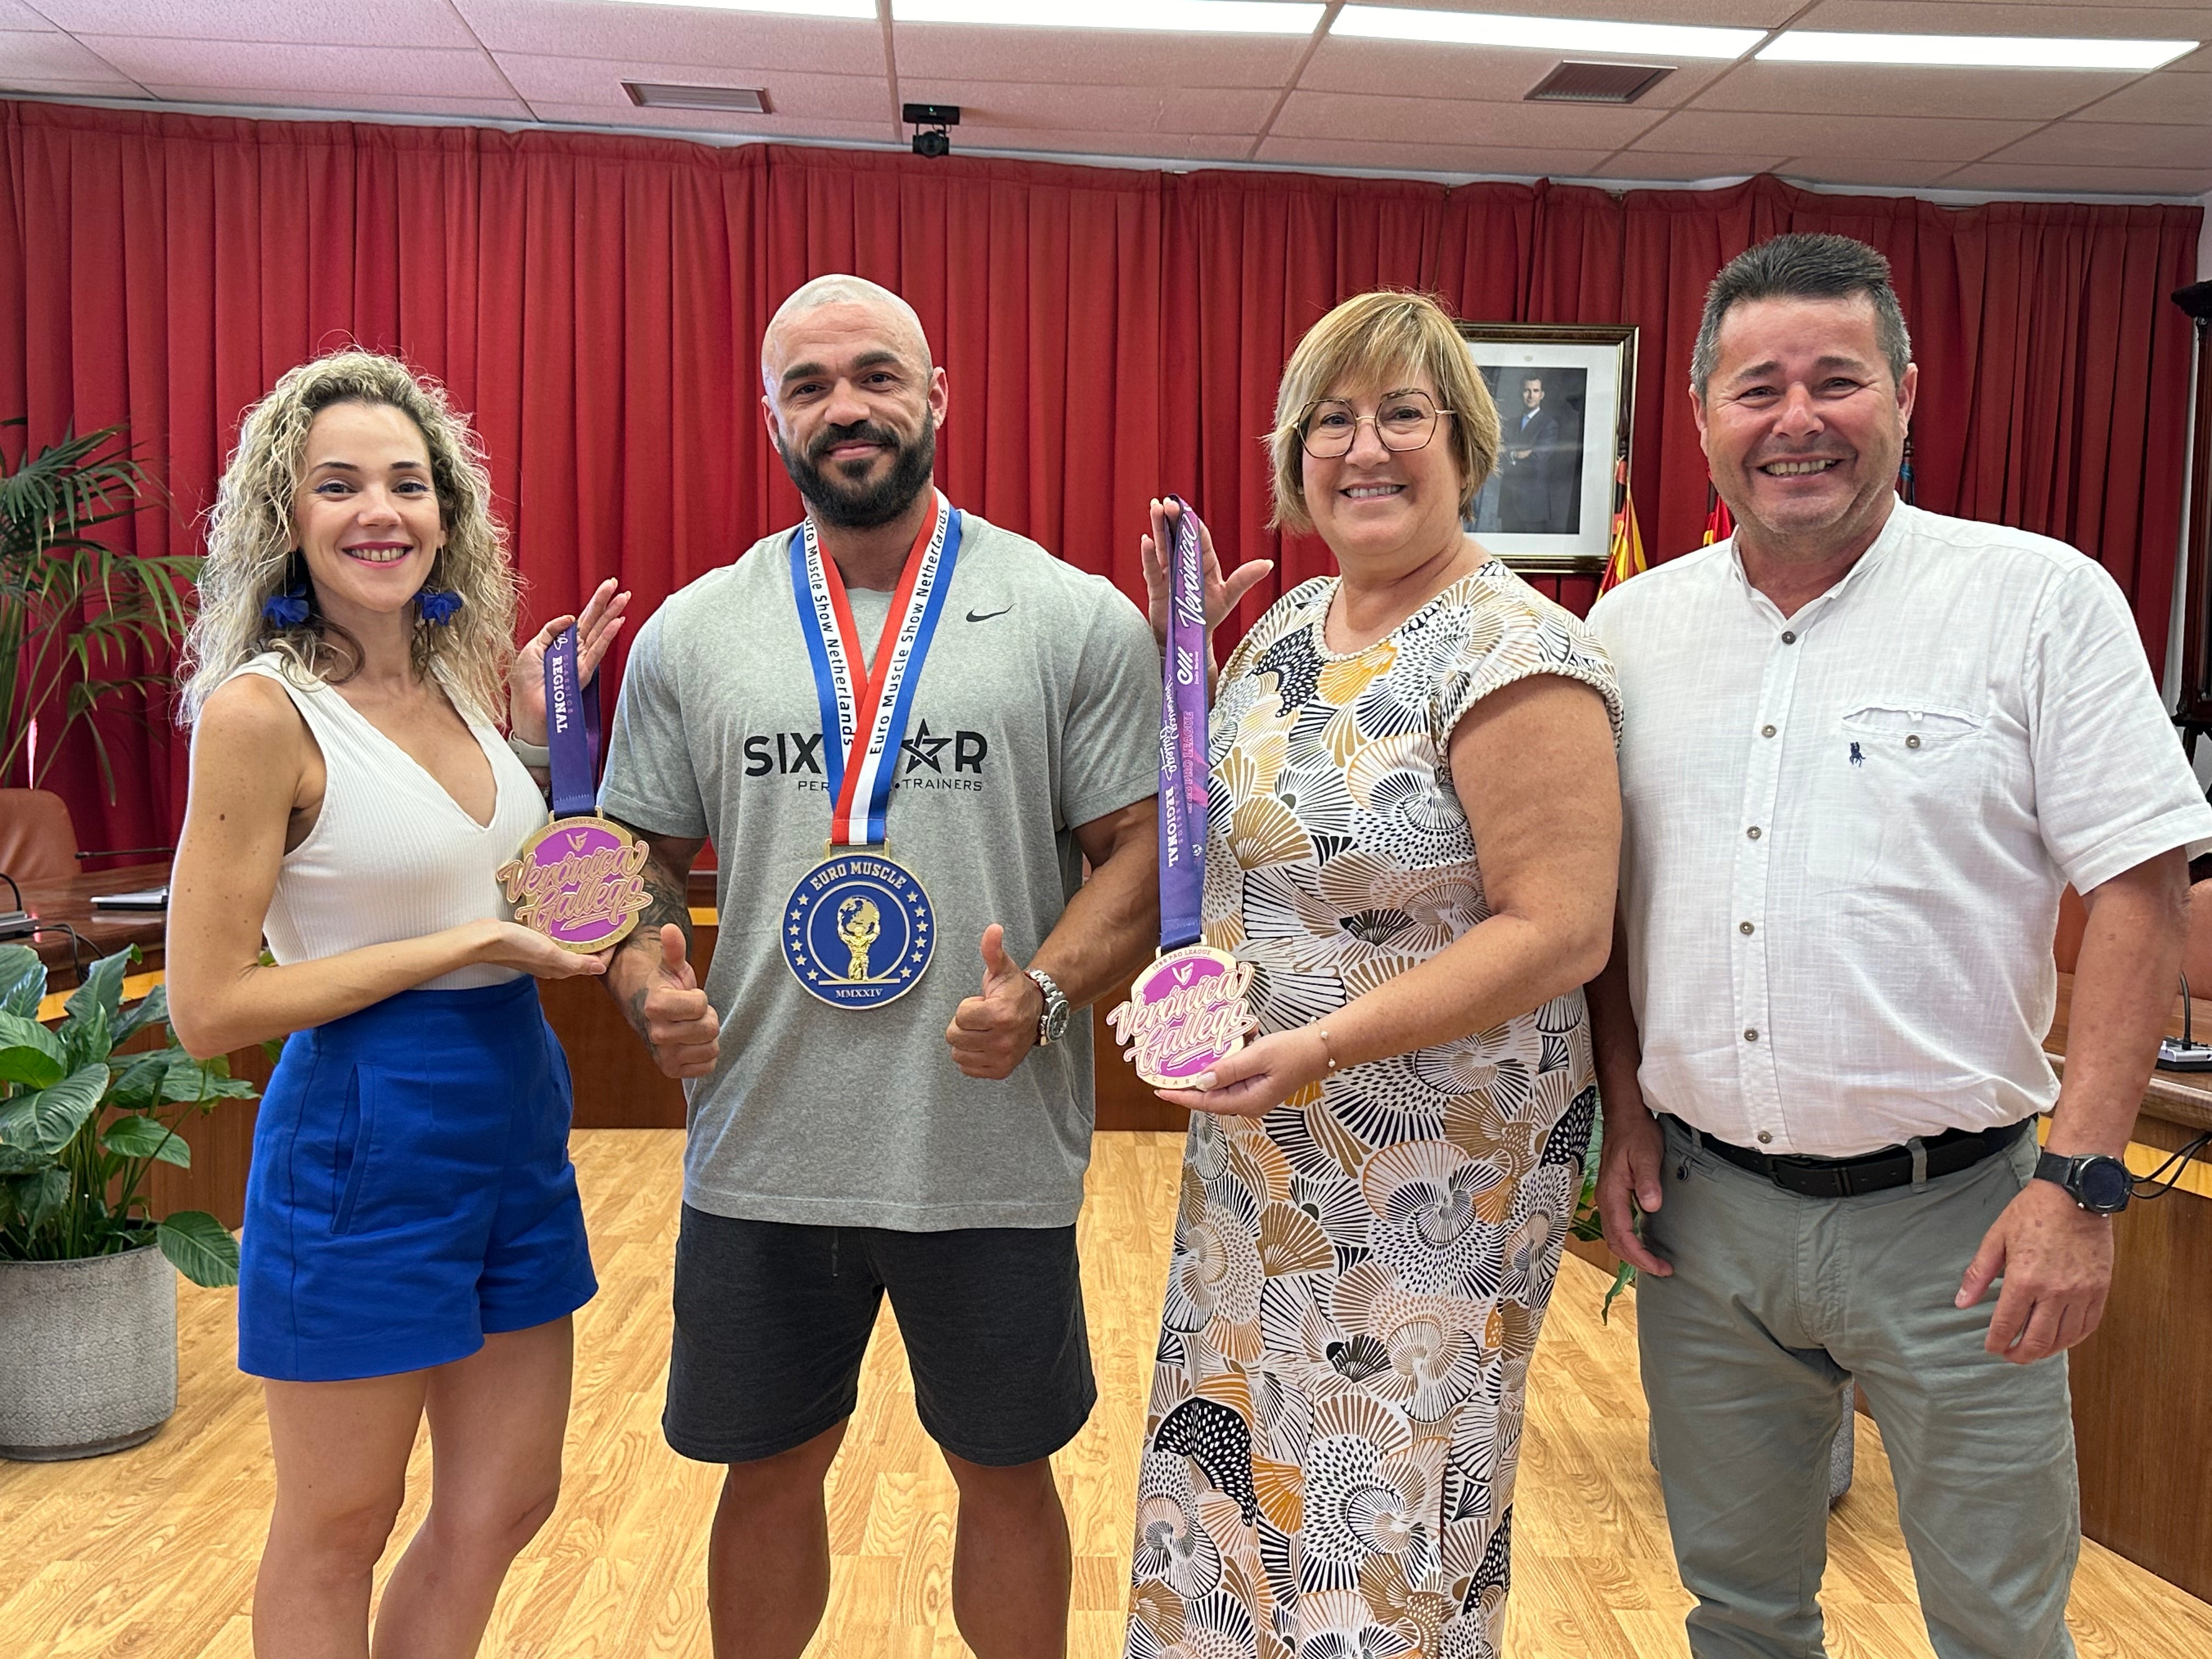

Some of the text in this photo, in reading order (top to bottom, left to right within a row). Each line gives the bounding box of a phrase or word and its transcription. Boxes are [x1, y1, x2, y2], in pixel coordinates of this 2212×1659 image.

[805, 518, 856, 746] uro Muscle Show Netherlands
[870, 509, 947, 755] Euro Muscle Show Netherlands
[552, 656, 568, 733] REGIONAL
[1182, 711, 1194, 758] LEAGUE
[902, 778, 984, 792] TRAINERS
[1165, 786, 1178, 867] REGIONAL
[515, 875, 653, 934] Gallego
[810, 861, 907, 891] EURO MUSCLE
[836, 989, 883, 998] MMXXIV
[1124, 998, 1260, 1076] Gallego
